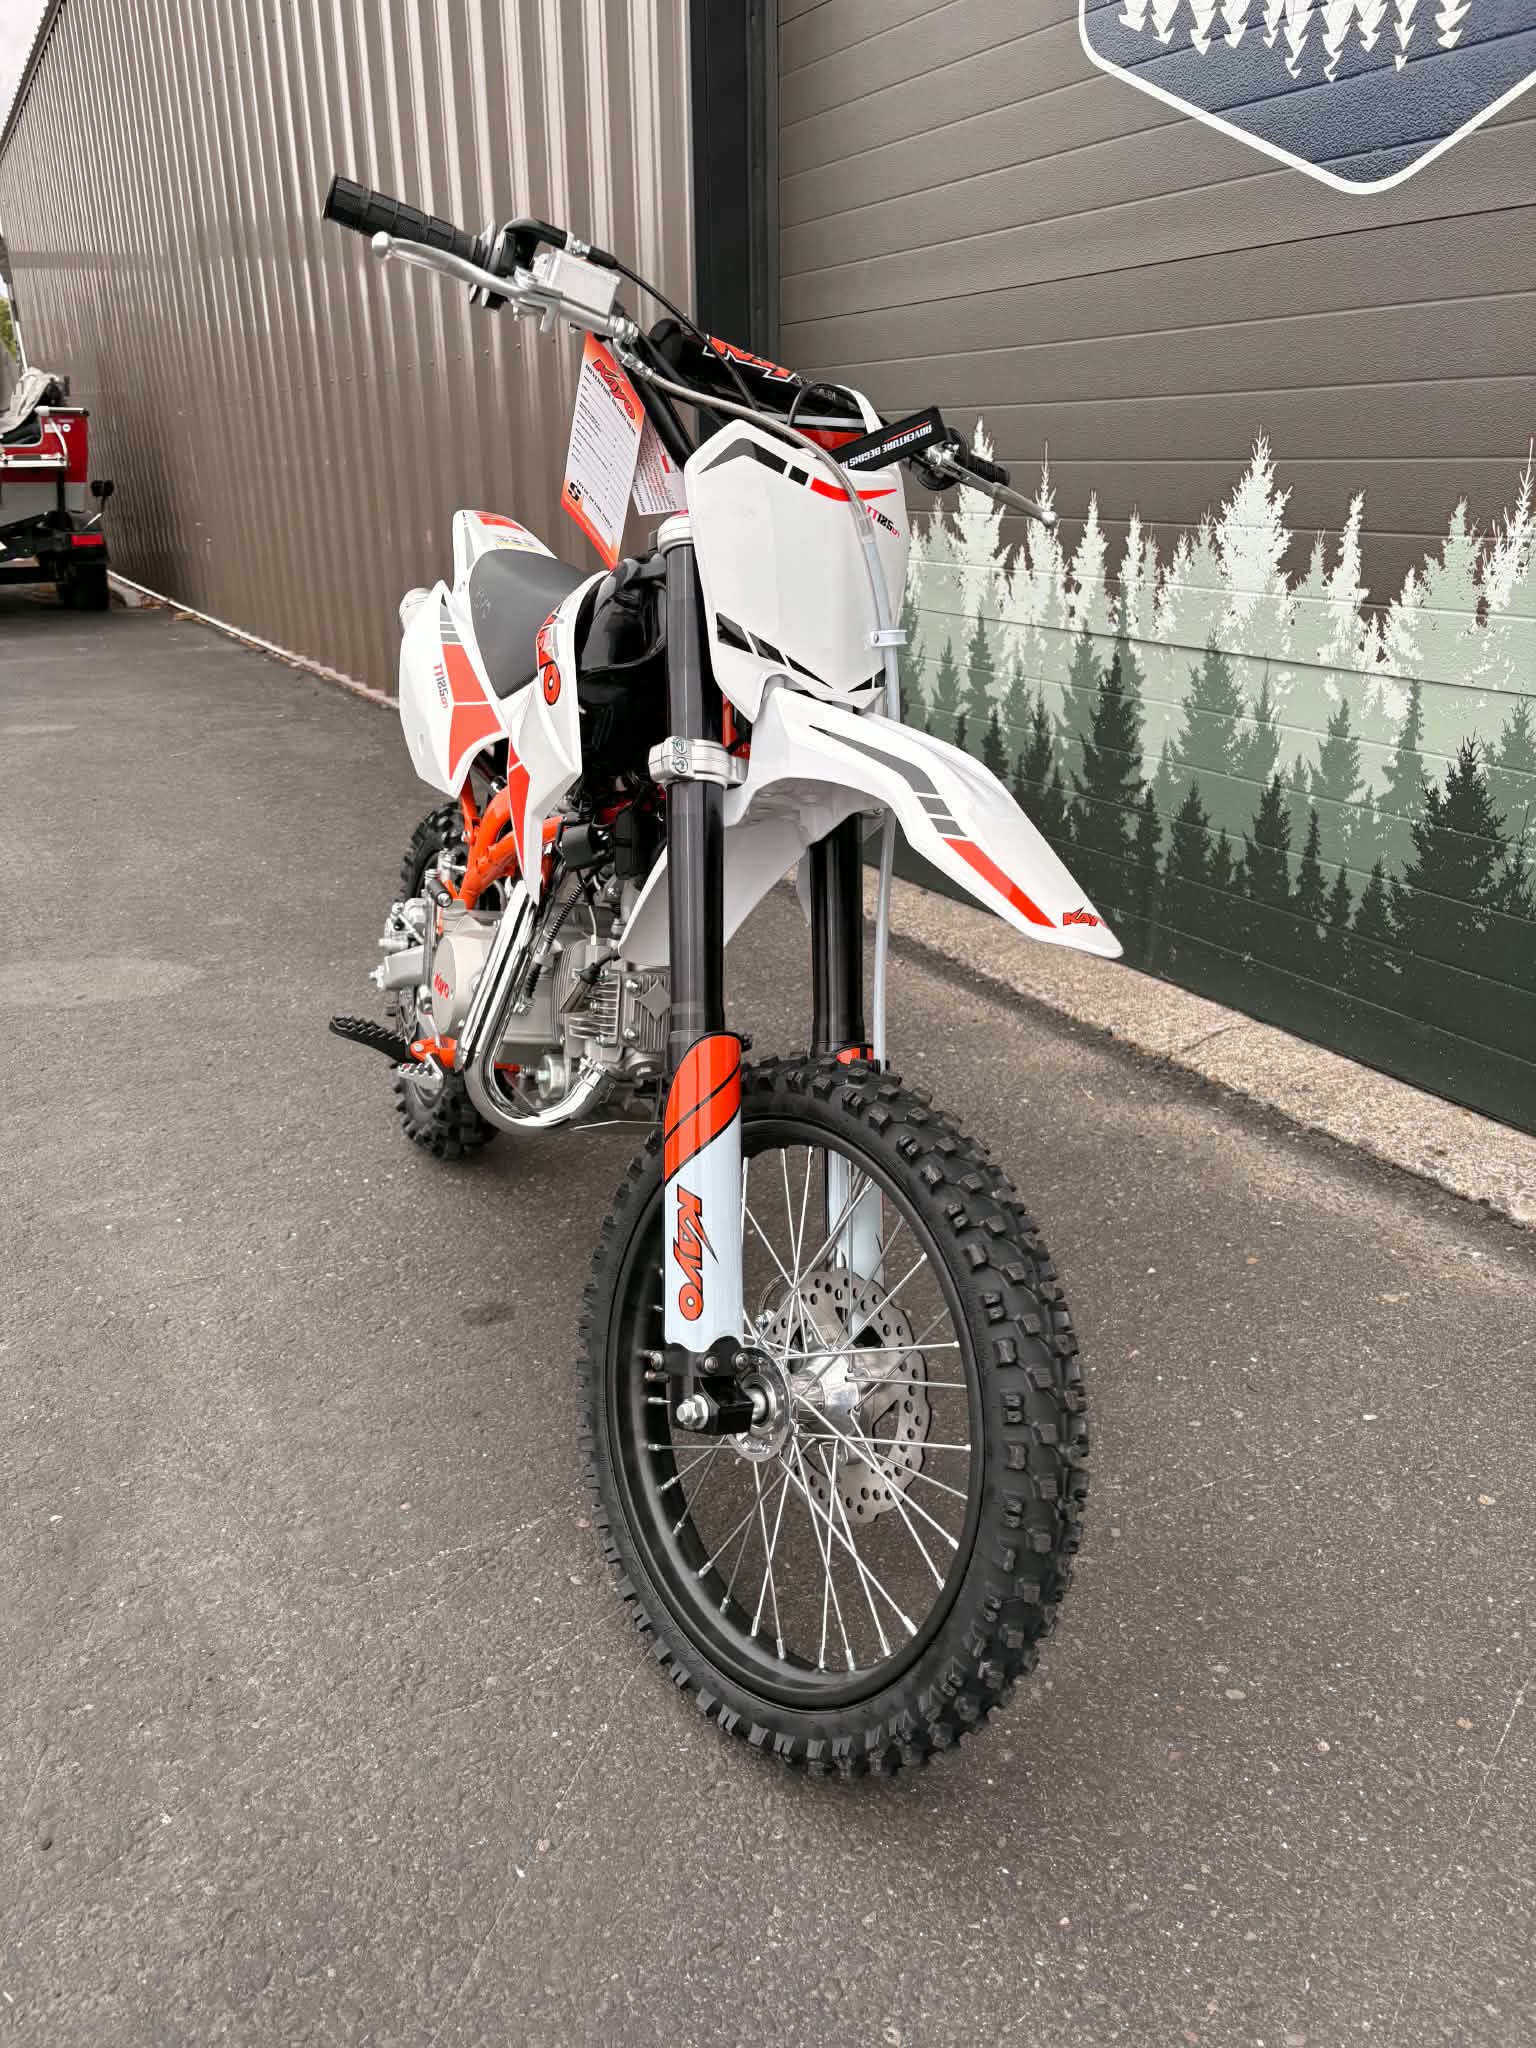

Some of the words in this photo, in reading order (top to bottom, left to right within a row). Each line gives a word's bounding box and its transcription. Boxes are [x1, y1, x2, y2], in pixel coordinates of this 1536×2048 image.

[592, 358, 635, 420] KAYO
[849, 446, 881, 467] BEGINS
[882, 424, 933, 455] ADVENTURE
[673, 1184, 720, 1321] KAYO
